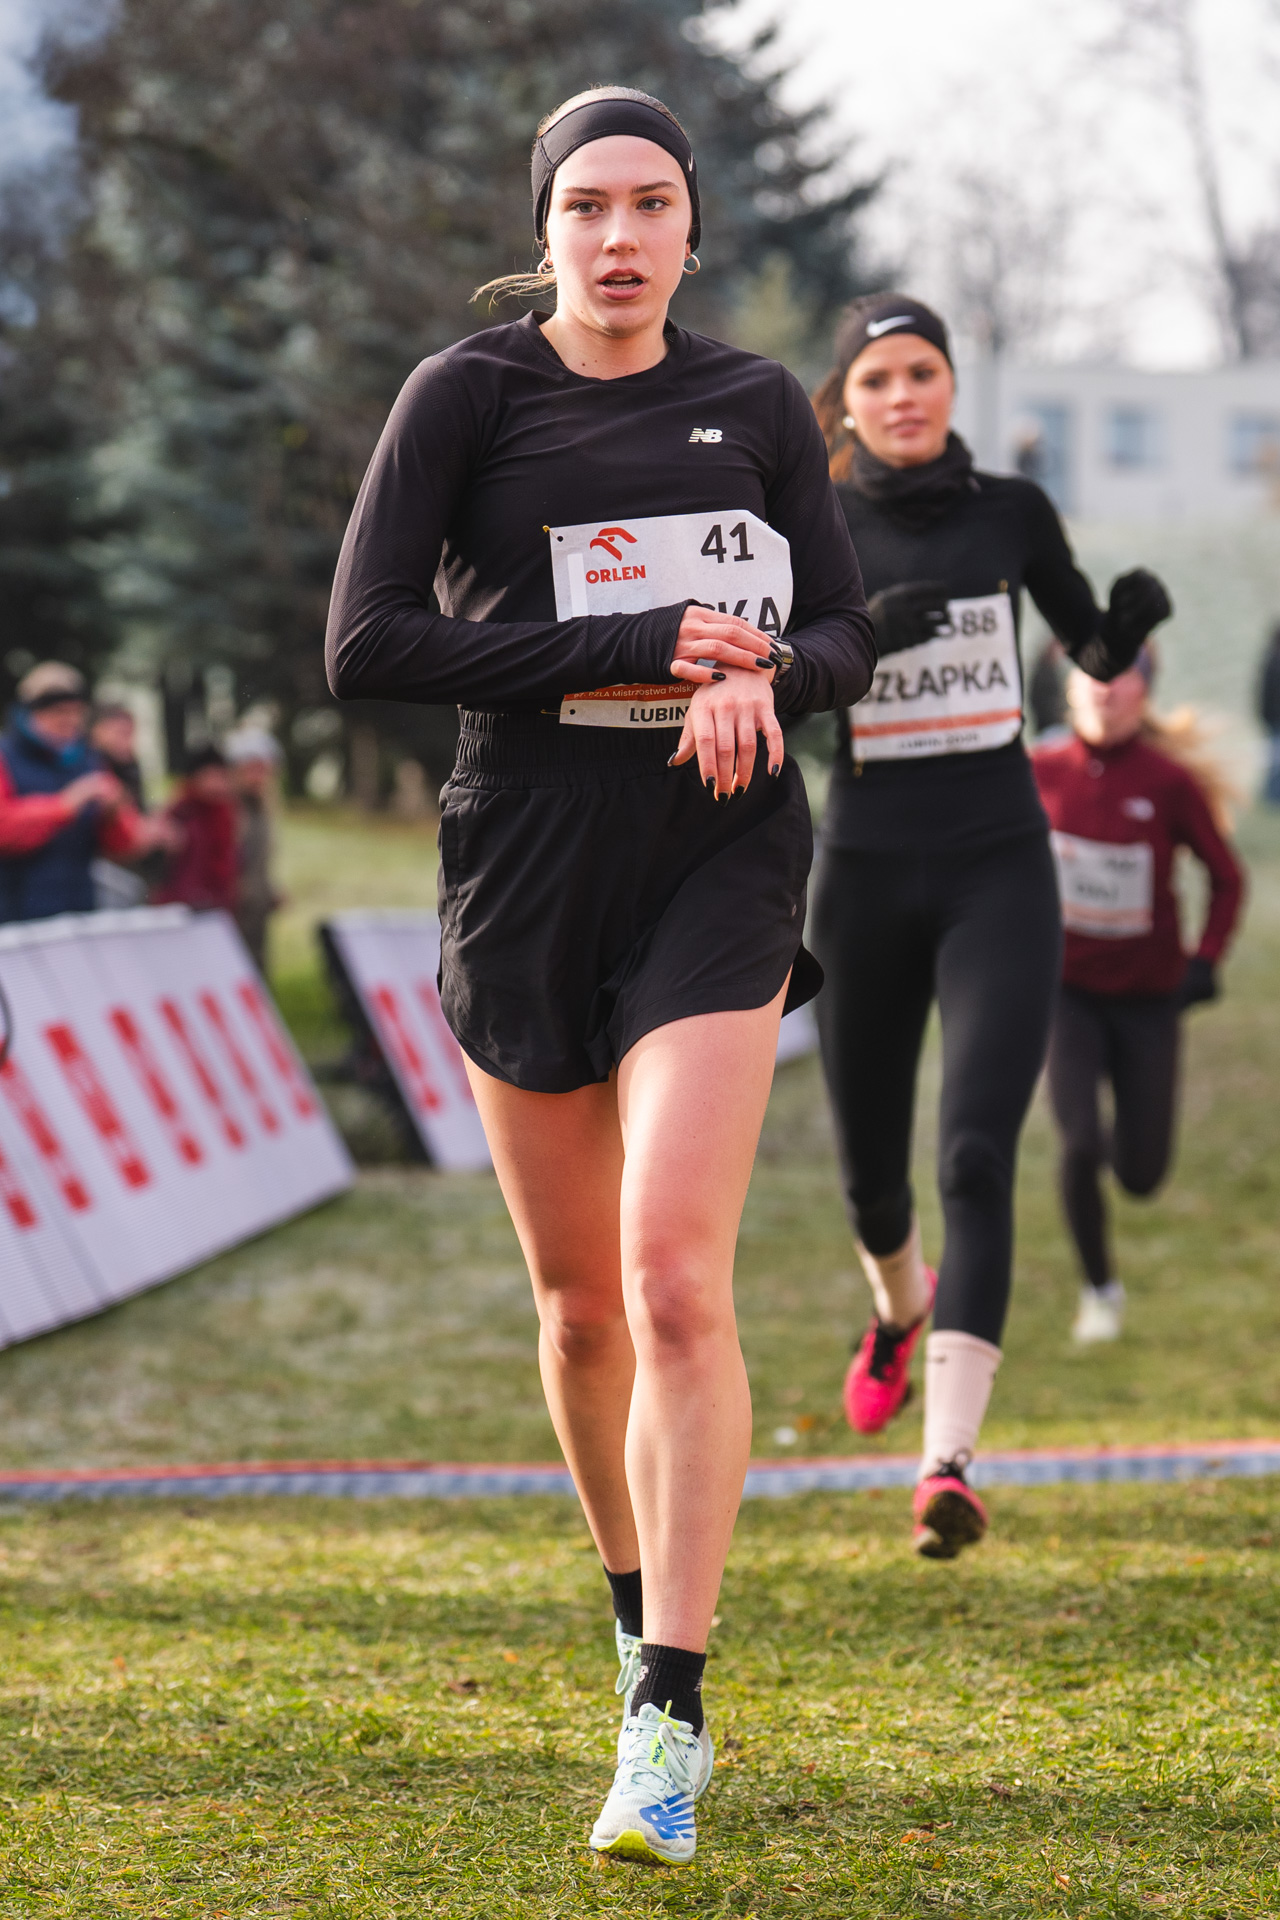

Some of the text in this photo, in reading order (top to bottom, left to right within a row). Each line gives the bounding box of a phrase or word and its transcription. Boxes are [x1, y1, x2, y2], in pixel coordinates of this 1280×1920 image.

[688, 427, 723, 443] NB
[700, 522, 754, 564] 41
[585, 564, 647, 584] ORLEN
[859, 658, 1010, 704] ZŁAPKA
[612, 685, 667, 698] Mistrzostwa
[668, 683, 694, 694] Polski
[629, 705, 690, 722] LUBIN
